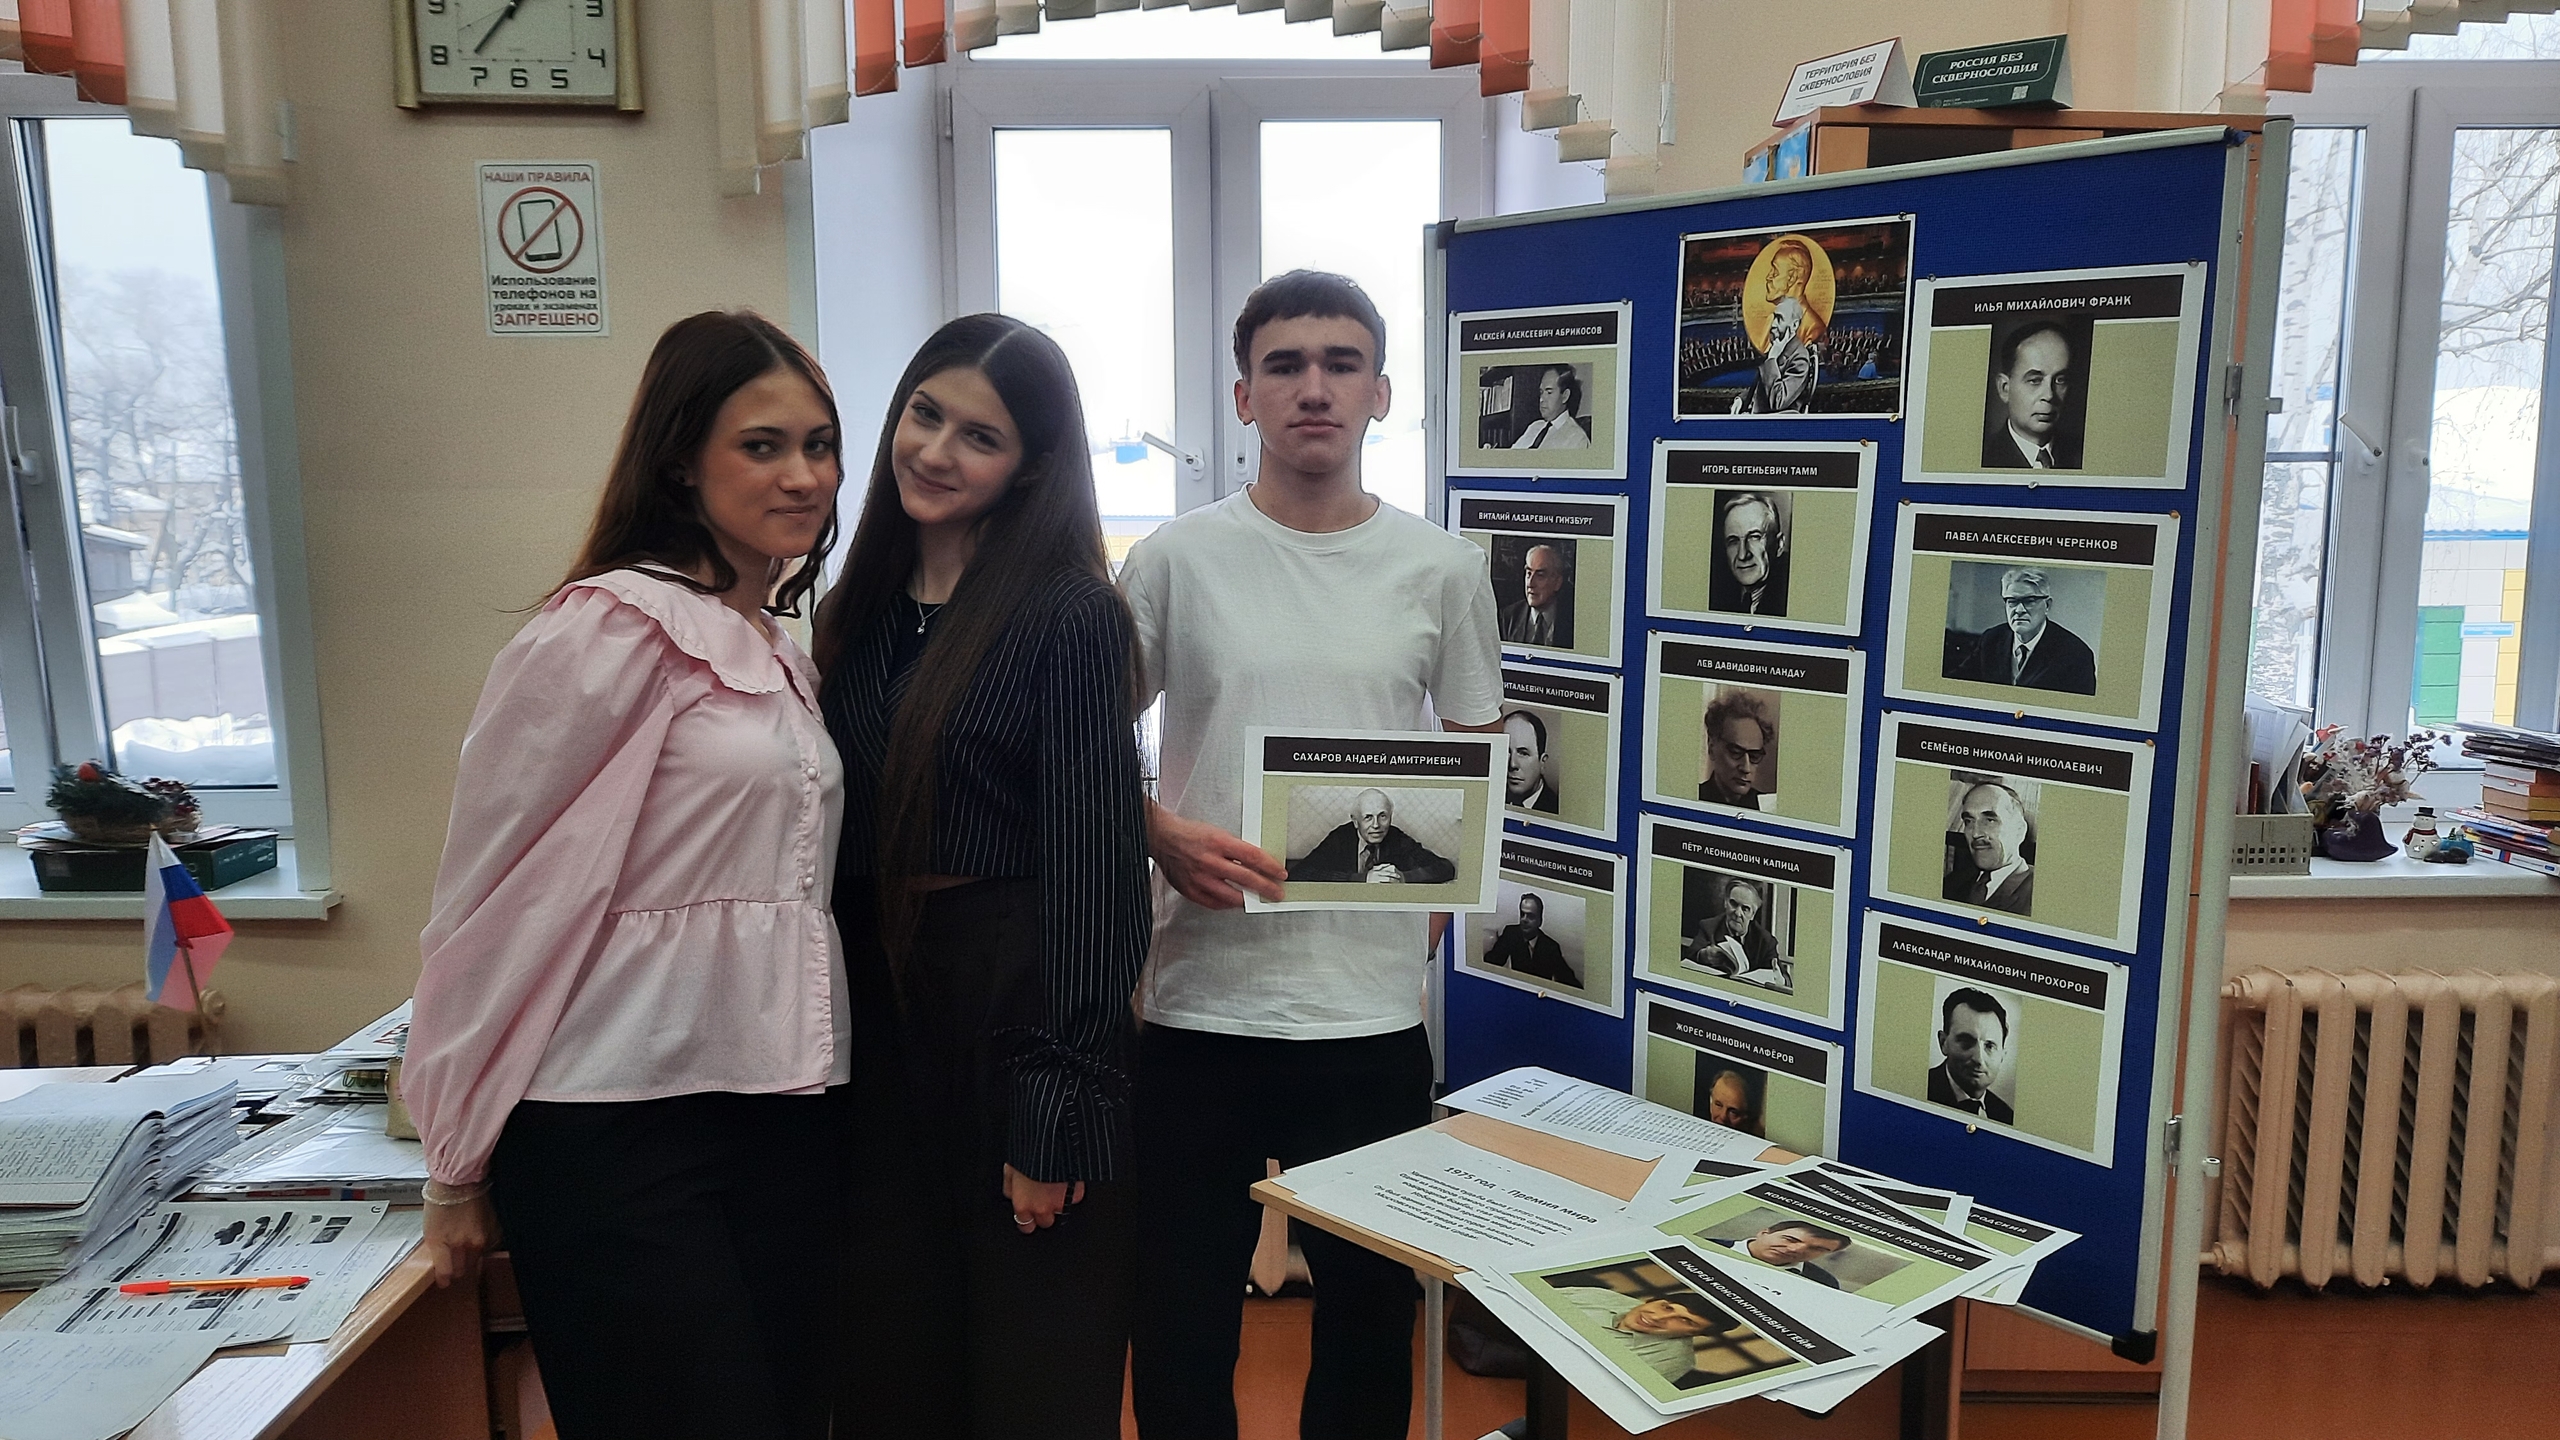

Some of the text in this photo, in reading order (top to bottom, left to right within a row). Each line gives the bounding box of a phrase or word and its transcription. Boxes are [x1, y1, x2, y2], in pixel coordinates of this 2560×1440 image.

[430, 45, 448, 65] 8
[588, 48, 606, 67] 4
[1949, 51, 2024, 71] РОССИЯ БЕЗ
[469, 67, 488, 86] 7
[1804, 53, 1877, 80] ТЕРРИТОРИЯ БЕЗ
[1932, 62, 2039, 85] СКВЕРНОСЛОВИЯ
[511, 68, 528, 88] 6
[550, 68, 568, 89] 5
[1798, 66, 1873, 93] СКВЕРНОСЛОВИЯ
[485, 171, 590, 182] НАШИ ПРАВИЛА
[491, 275, 597, 286] Использование
[493, 288, 596, 301] телефонов на
[1974, 295, 2132, 313] ИЛЬЯ МИХАЙЛОВИЧ ФРАНК
[493, 303, 530, 311] уроках
[494, 313, 599, 326] ЗАПРЕЩЕНО
[1473, 326, 1602, 341] АЛЕКСЕЙ АЛЕКСЕЕВИЧ АБРИКОСОВ
[1701, 464, 1818, 476] ИГОРЬ ЕВГЕНЬЕВИЧ ТАММ
[1478, 511, 1593, 525] ВИТАЛИЙ ЛАЗАРЕВИЧ ГИНЗБУРГ
[1945, 531, 2118, 550] ПАВЕЛ АЛЕКСЕЕВИЧ ЧЕРЕНКОВ
[1696, 659, 1806, 678] ЛЕВ ДАВИДОВИЧ ЛАНДАУ
[1503, 681, 1595, 701] ИТАЛЬЕВИЧ КАНТОРОВИЧ
[1292, 752, 1461, 766] САХАРОВ АНДРЕЙ ДМИТРИЕВИЧ
[1920, 740, 2103, 775] СЕМЁНОВ НИКОЛАЙ НИКОЛАЕВИЧ
[1517, 854, 1567, 873] ГЕННАДИЕВИЧ
[1568, 865, 1593, 878] БАСОВ
[1682, 841, 1800, 873] ПЁТР ЛЕОНИДОВИЧ КАПИЦА
[1891, 939, 2091, 995] АЛЕКСАНДР МИХАЙЛОВИЧ ПРОХОРОВ
[1676, 1022, 1795, 1065] ЖОРЕС ИВАНОВИЧ АЛФЁРОВ
[1443, 1167, 1475, 1180] 1975
[1474, 1178, 1497, 1189] год
[1507, 1189, 1560, 1210] Премия
[1559, 1208, 1598, 1224] мира
[1818, 1183, 1857, 1203] МИХАИЛ
[1764, 1190, 1965, 1263] КОНСТАНТИН СЕРГЕЕВИЧ НОВОСЁЛОВ
[1968, 1212, 2028, 1234] РОДСКИЙ
[1677, 1258, 1817, 1350] АНДРЕЙ КОНСТАНТИНОВИЧ ГЕЙМ
